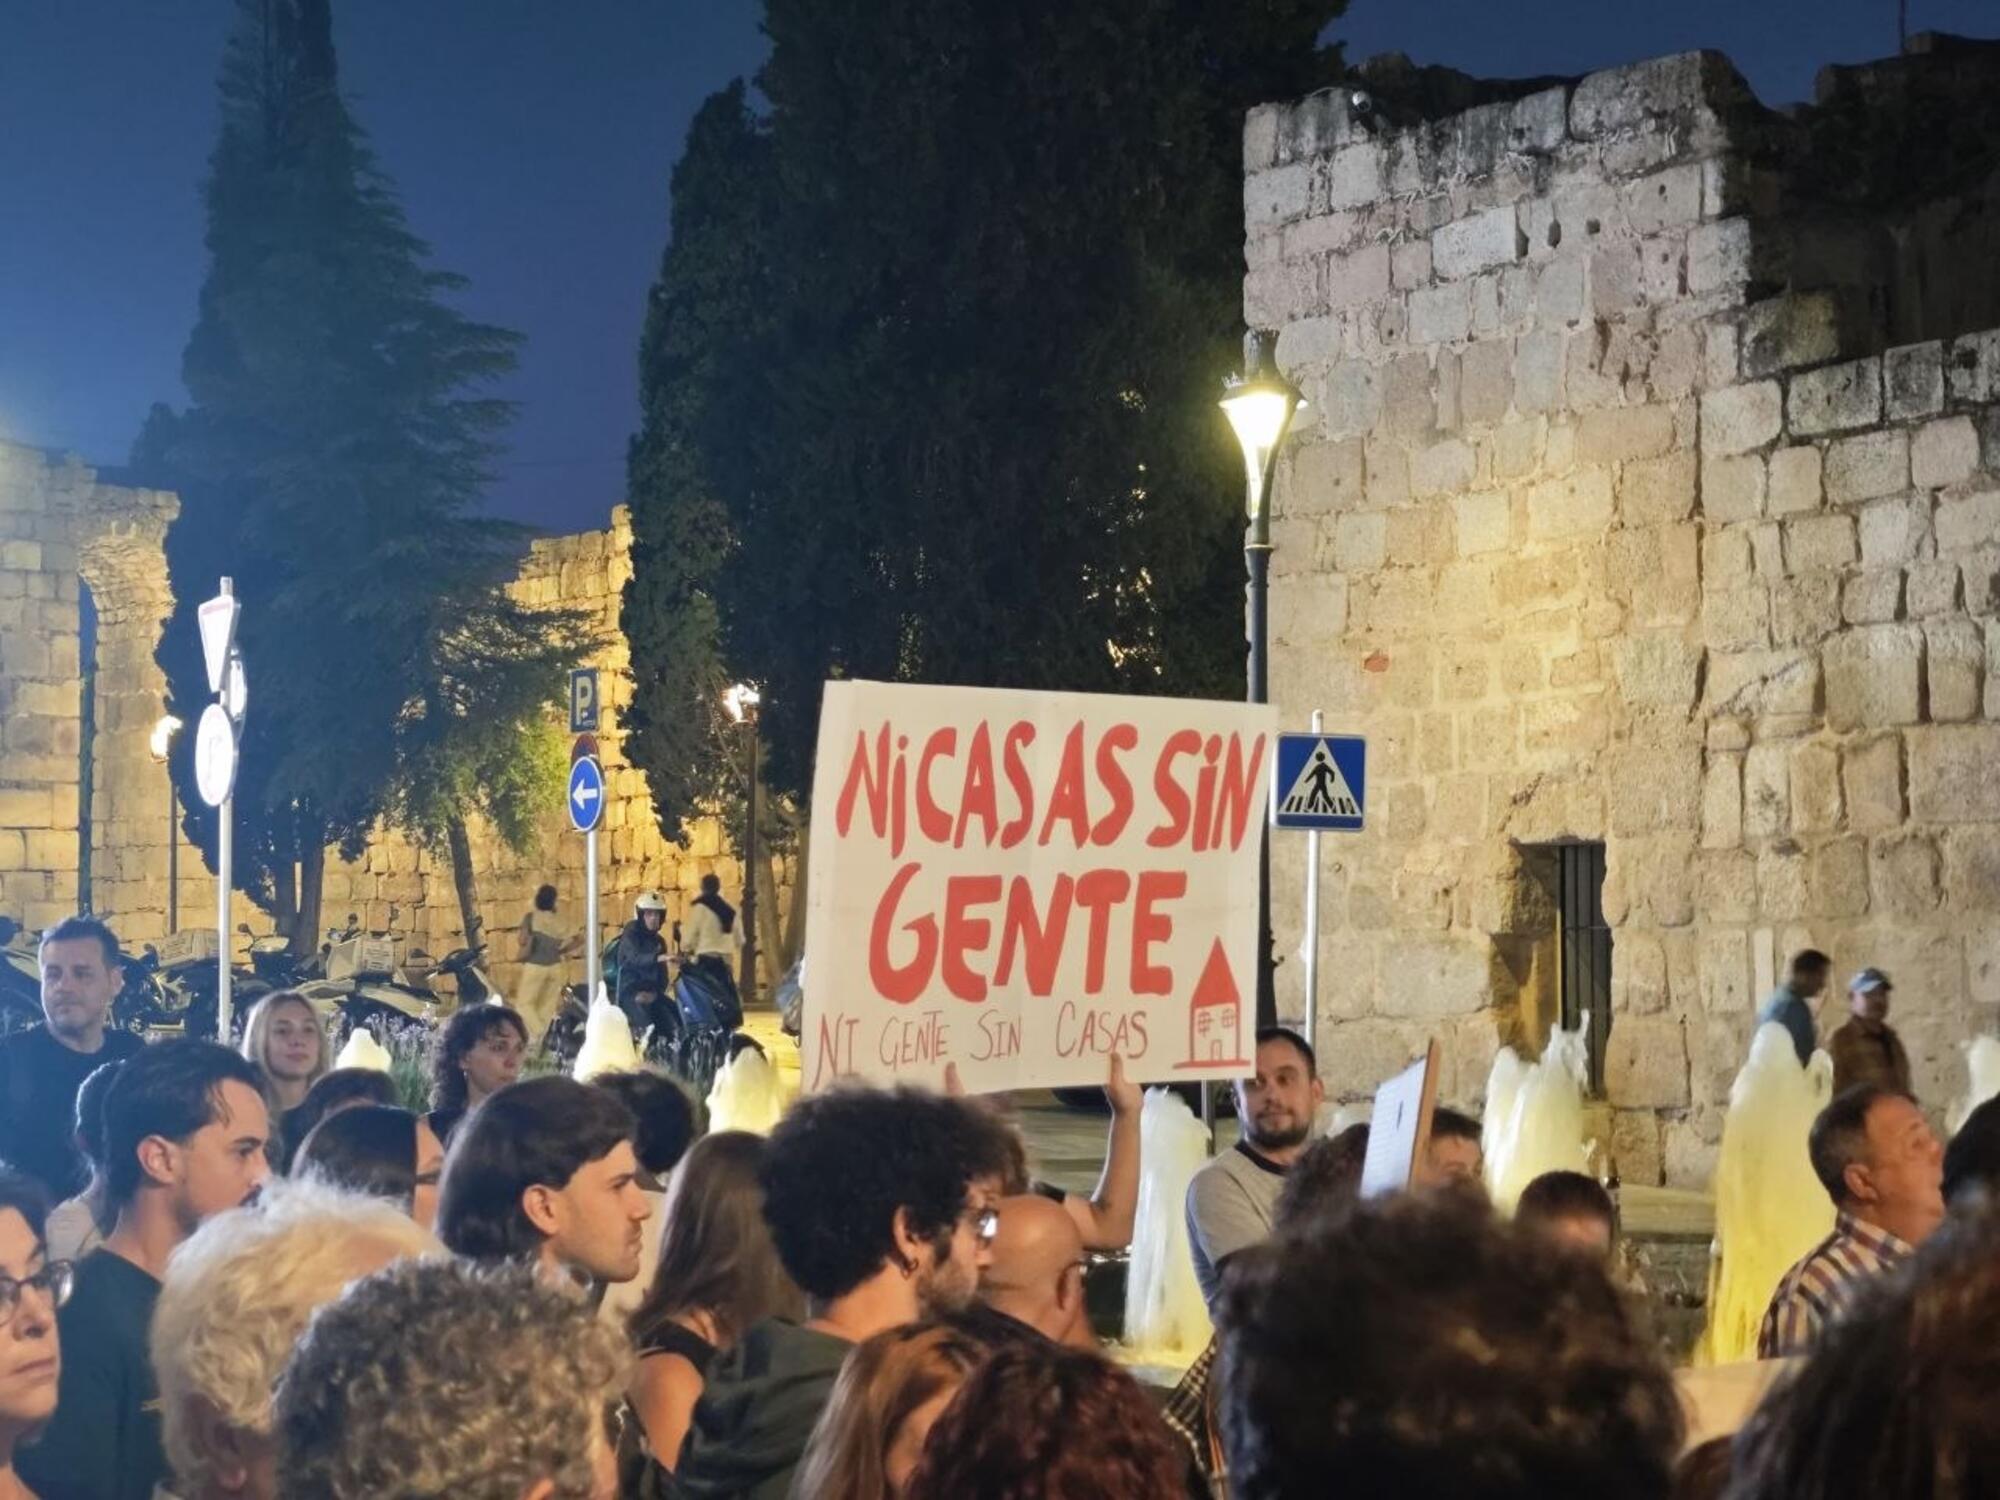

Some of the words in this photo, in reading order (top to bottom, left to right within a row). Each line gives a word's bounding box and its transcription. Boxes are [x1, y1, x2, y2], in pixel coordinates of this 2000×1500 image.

[576, 676, 593, 725] P
[915, 720, 1139, 849] CASAS
[869, 862, 1188, 1005] GENTE
[879, 1009, 951, 1072] GENTE
[969, 1008, 1022, 1062] SIN
[1055, 1000, 1149, 1060] CASAS
